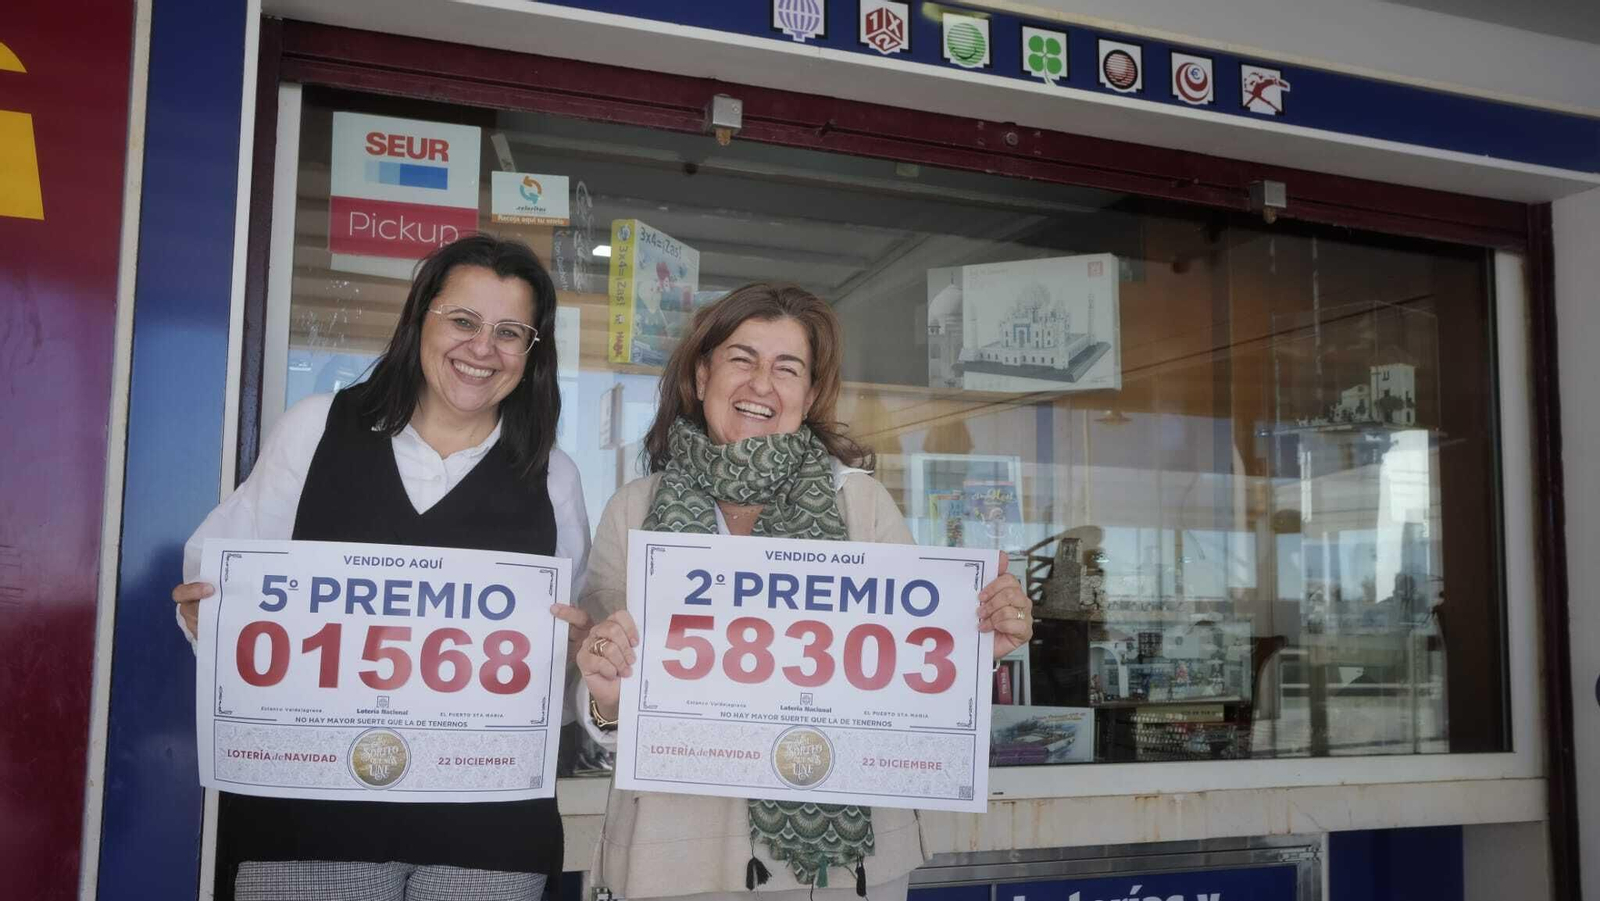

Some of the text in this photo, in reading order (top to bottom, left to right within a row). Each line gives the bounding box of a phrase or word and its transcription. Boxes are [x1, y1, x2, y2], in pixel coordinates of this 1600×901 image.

[365, 132, 450, 162] SEUR
[349, 211, 459, 249] Pickup
[343, 555, 444, 570] VENDIDO AQUÍ
[765, 550, 866, 565] VENDIDO AQUÍ
[258, 574, 517, 621] 5º PREMIO
[684, 569, 940, 618] 2º PREMIO
[235, 620, 532, 695] 01568
[661, 614, 957, 695] 58303
[805, 705, 832, 713] Nacional
[327, 717, 355, 725] MAYOR
[428, 720, 468, 728] TENERNOS
[852, 719, 892, 727] TENERNOS
[227, 749, 271, 760] LOTERÍA
[284, 753, 337, 762] NAVIDAD
[650, 744, 696, 757] LOTERÍA
[709, 748, 761, 760] NAVIDAD
[438, 757, 516, 766] 22 DICIEMBRE
[862, 758, 943, 770] 22 DICIEMBRE
